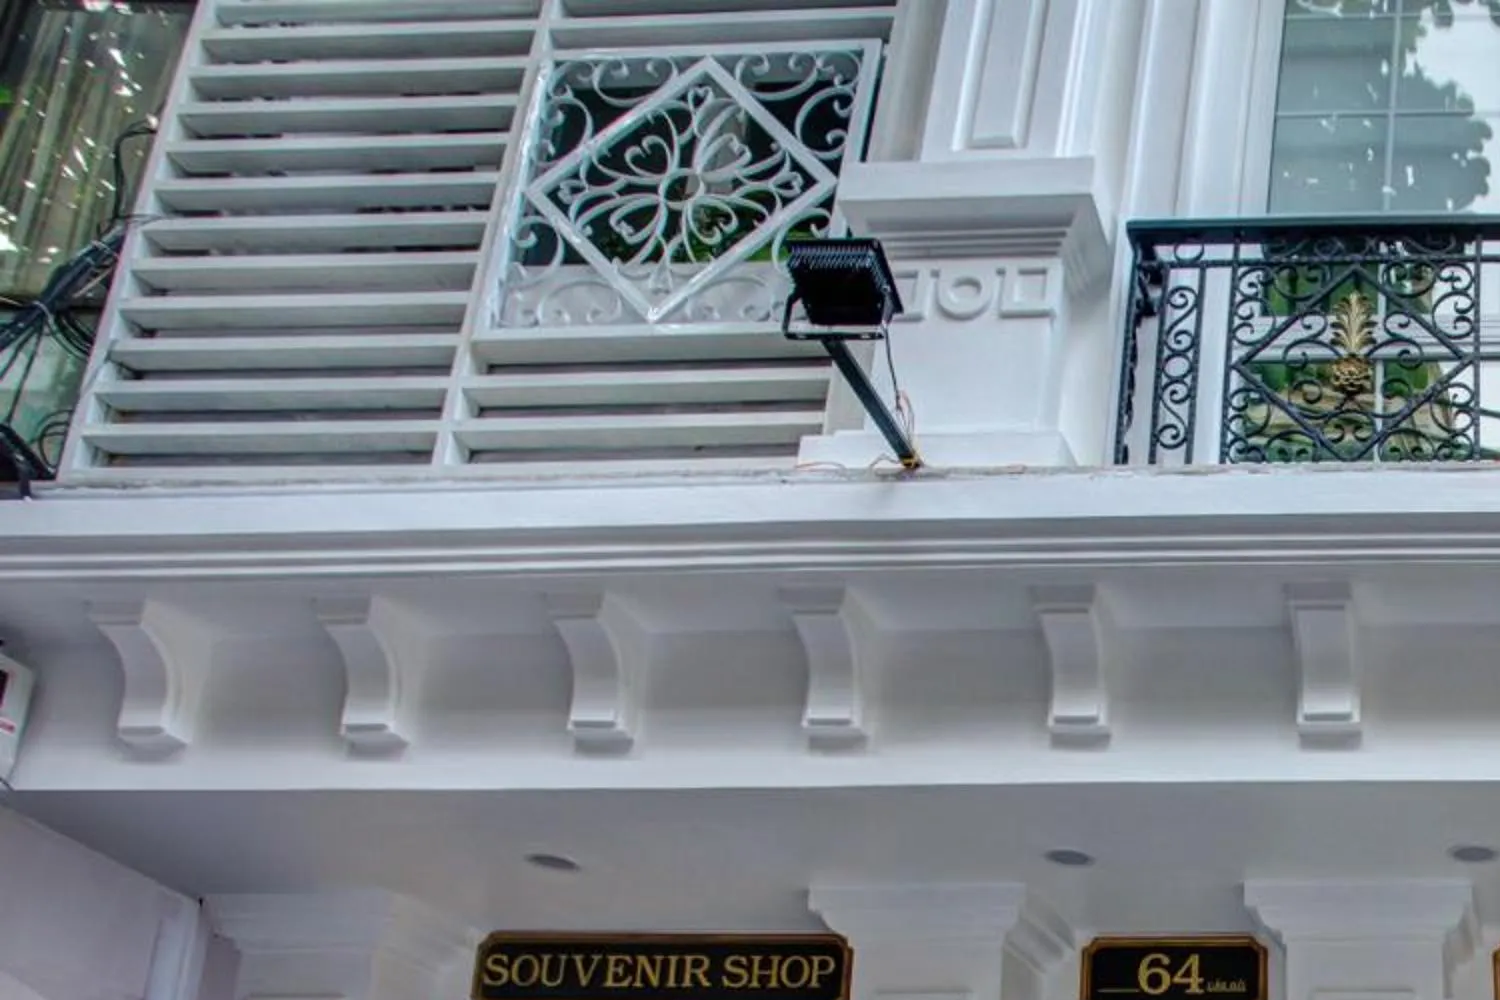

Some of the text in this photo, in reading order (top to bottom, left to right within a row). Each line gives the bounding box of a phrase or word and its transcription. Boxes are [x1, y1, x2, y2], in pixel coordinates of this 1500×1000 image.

[482, 954, 836, 988] SOUVENIR SHOP
[1137, 953, 1205, 995] 64
